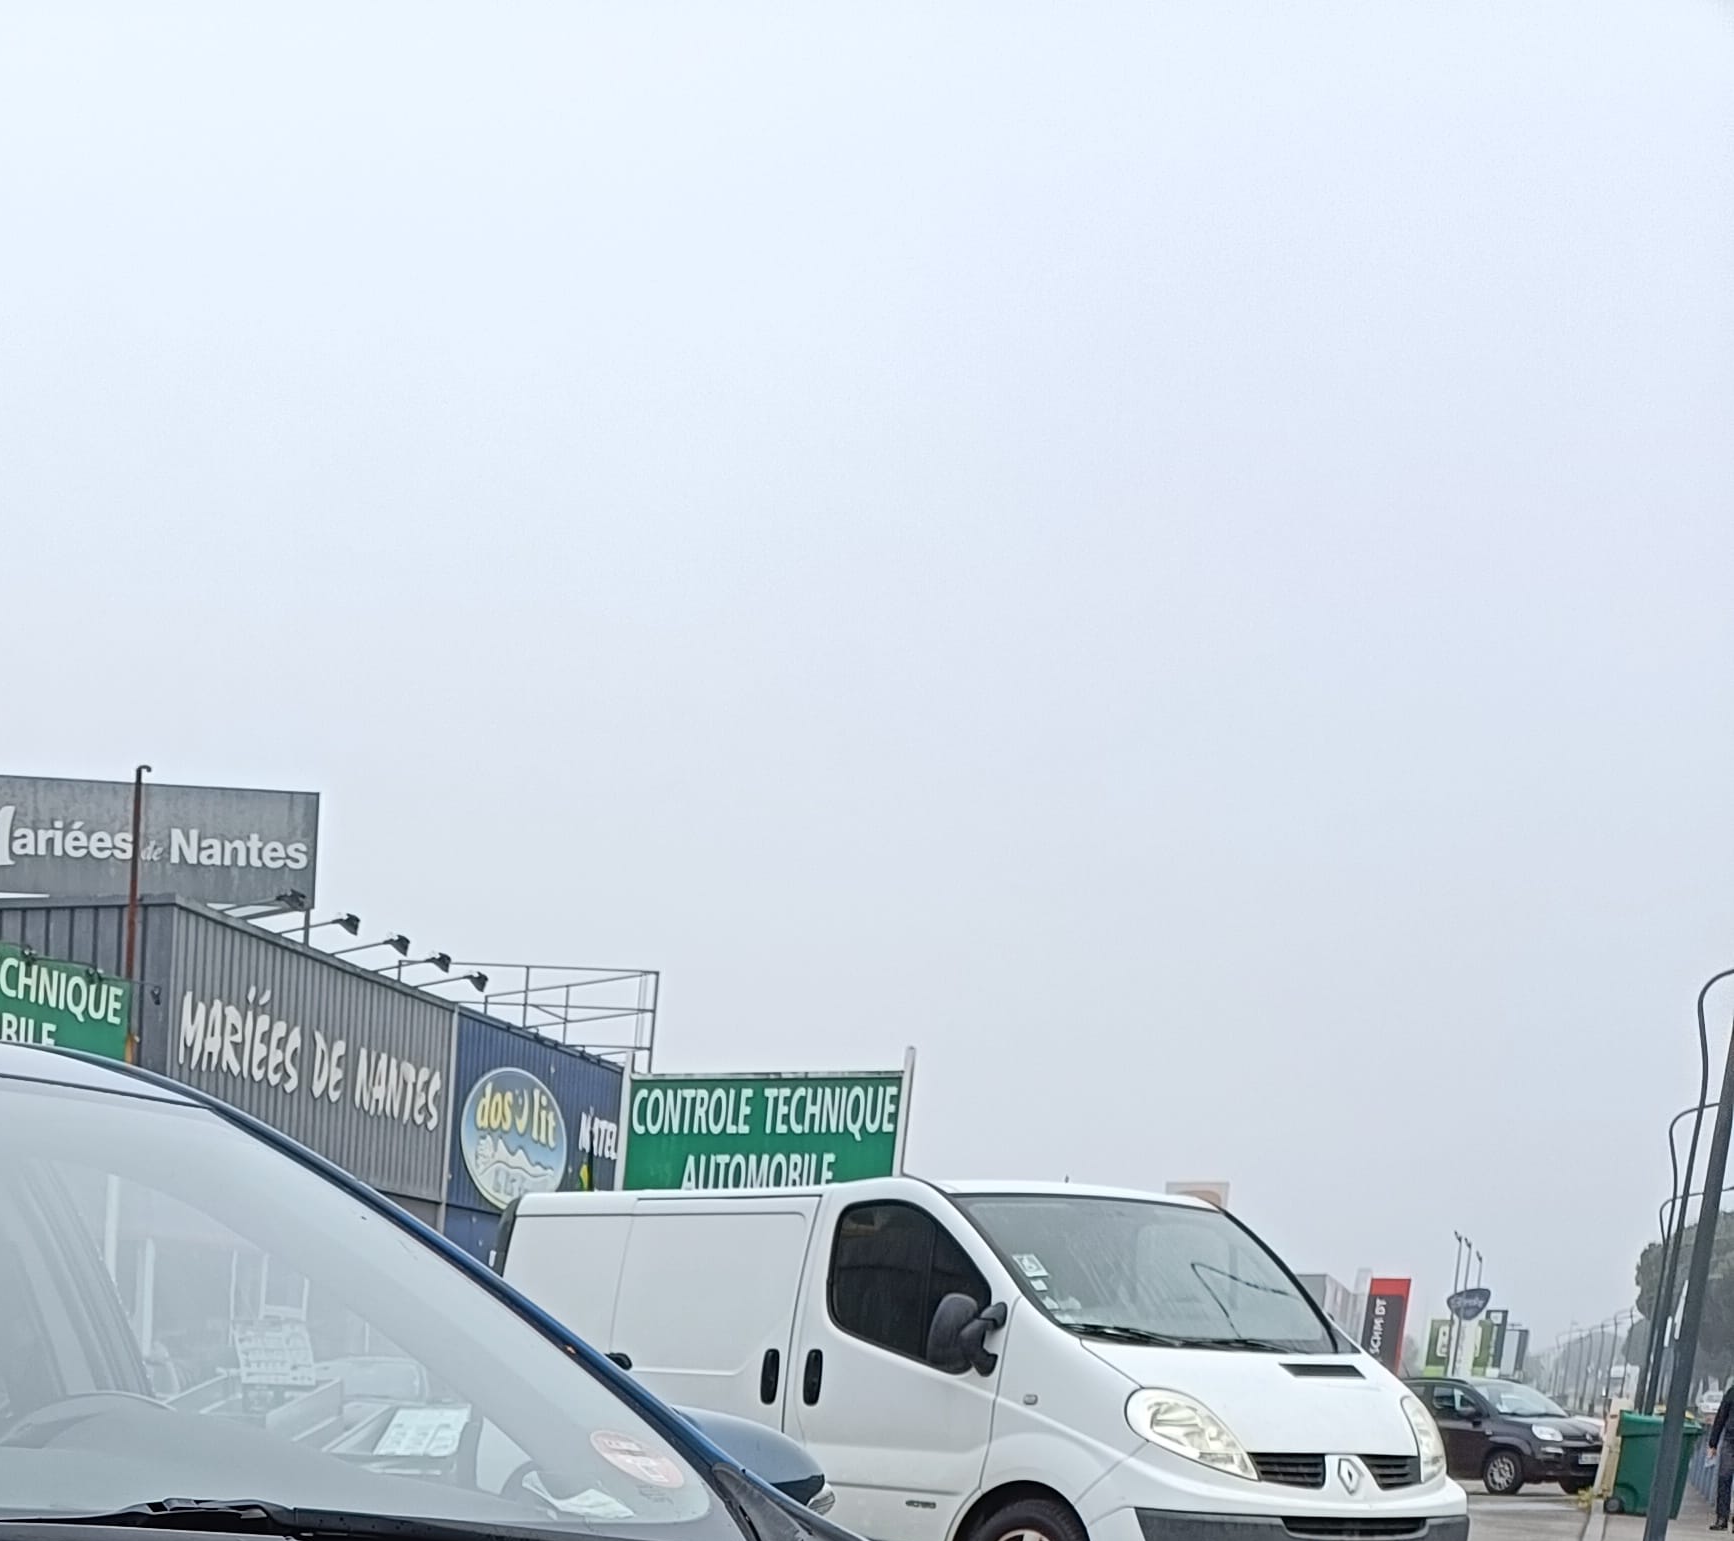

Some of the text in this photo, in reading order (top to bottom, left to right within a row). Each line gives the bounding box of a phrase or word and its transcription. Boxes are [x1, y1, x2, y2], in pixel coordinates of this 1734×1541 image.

[140, 840, 164, 862] de
[171, 828, 308, 870] Nantes
[311, 1030, 347, 1103] DE
[355, 1047, 441, 1132] NANTES
[476, 1082, 514, 1132] dos
[632, 1085, 899, 1141] CONTROLE TECHNIQUE
[681, 1152, 836, 1190] AUTOMOBILE
